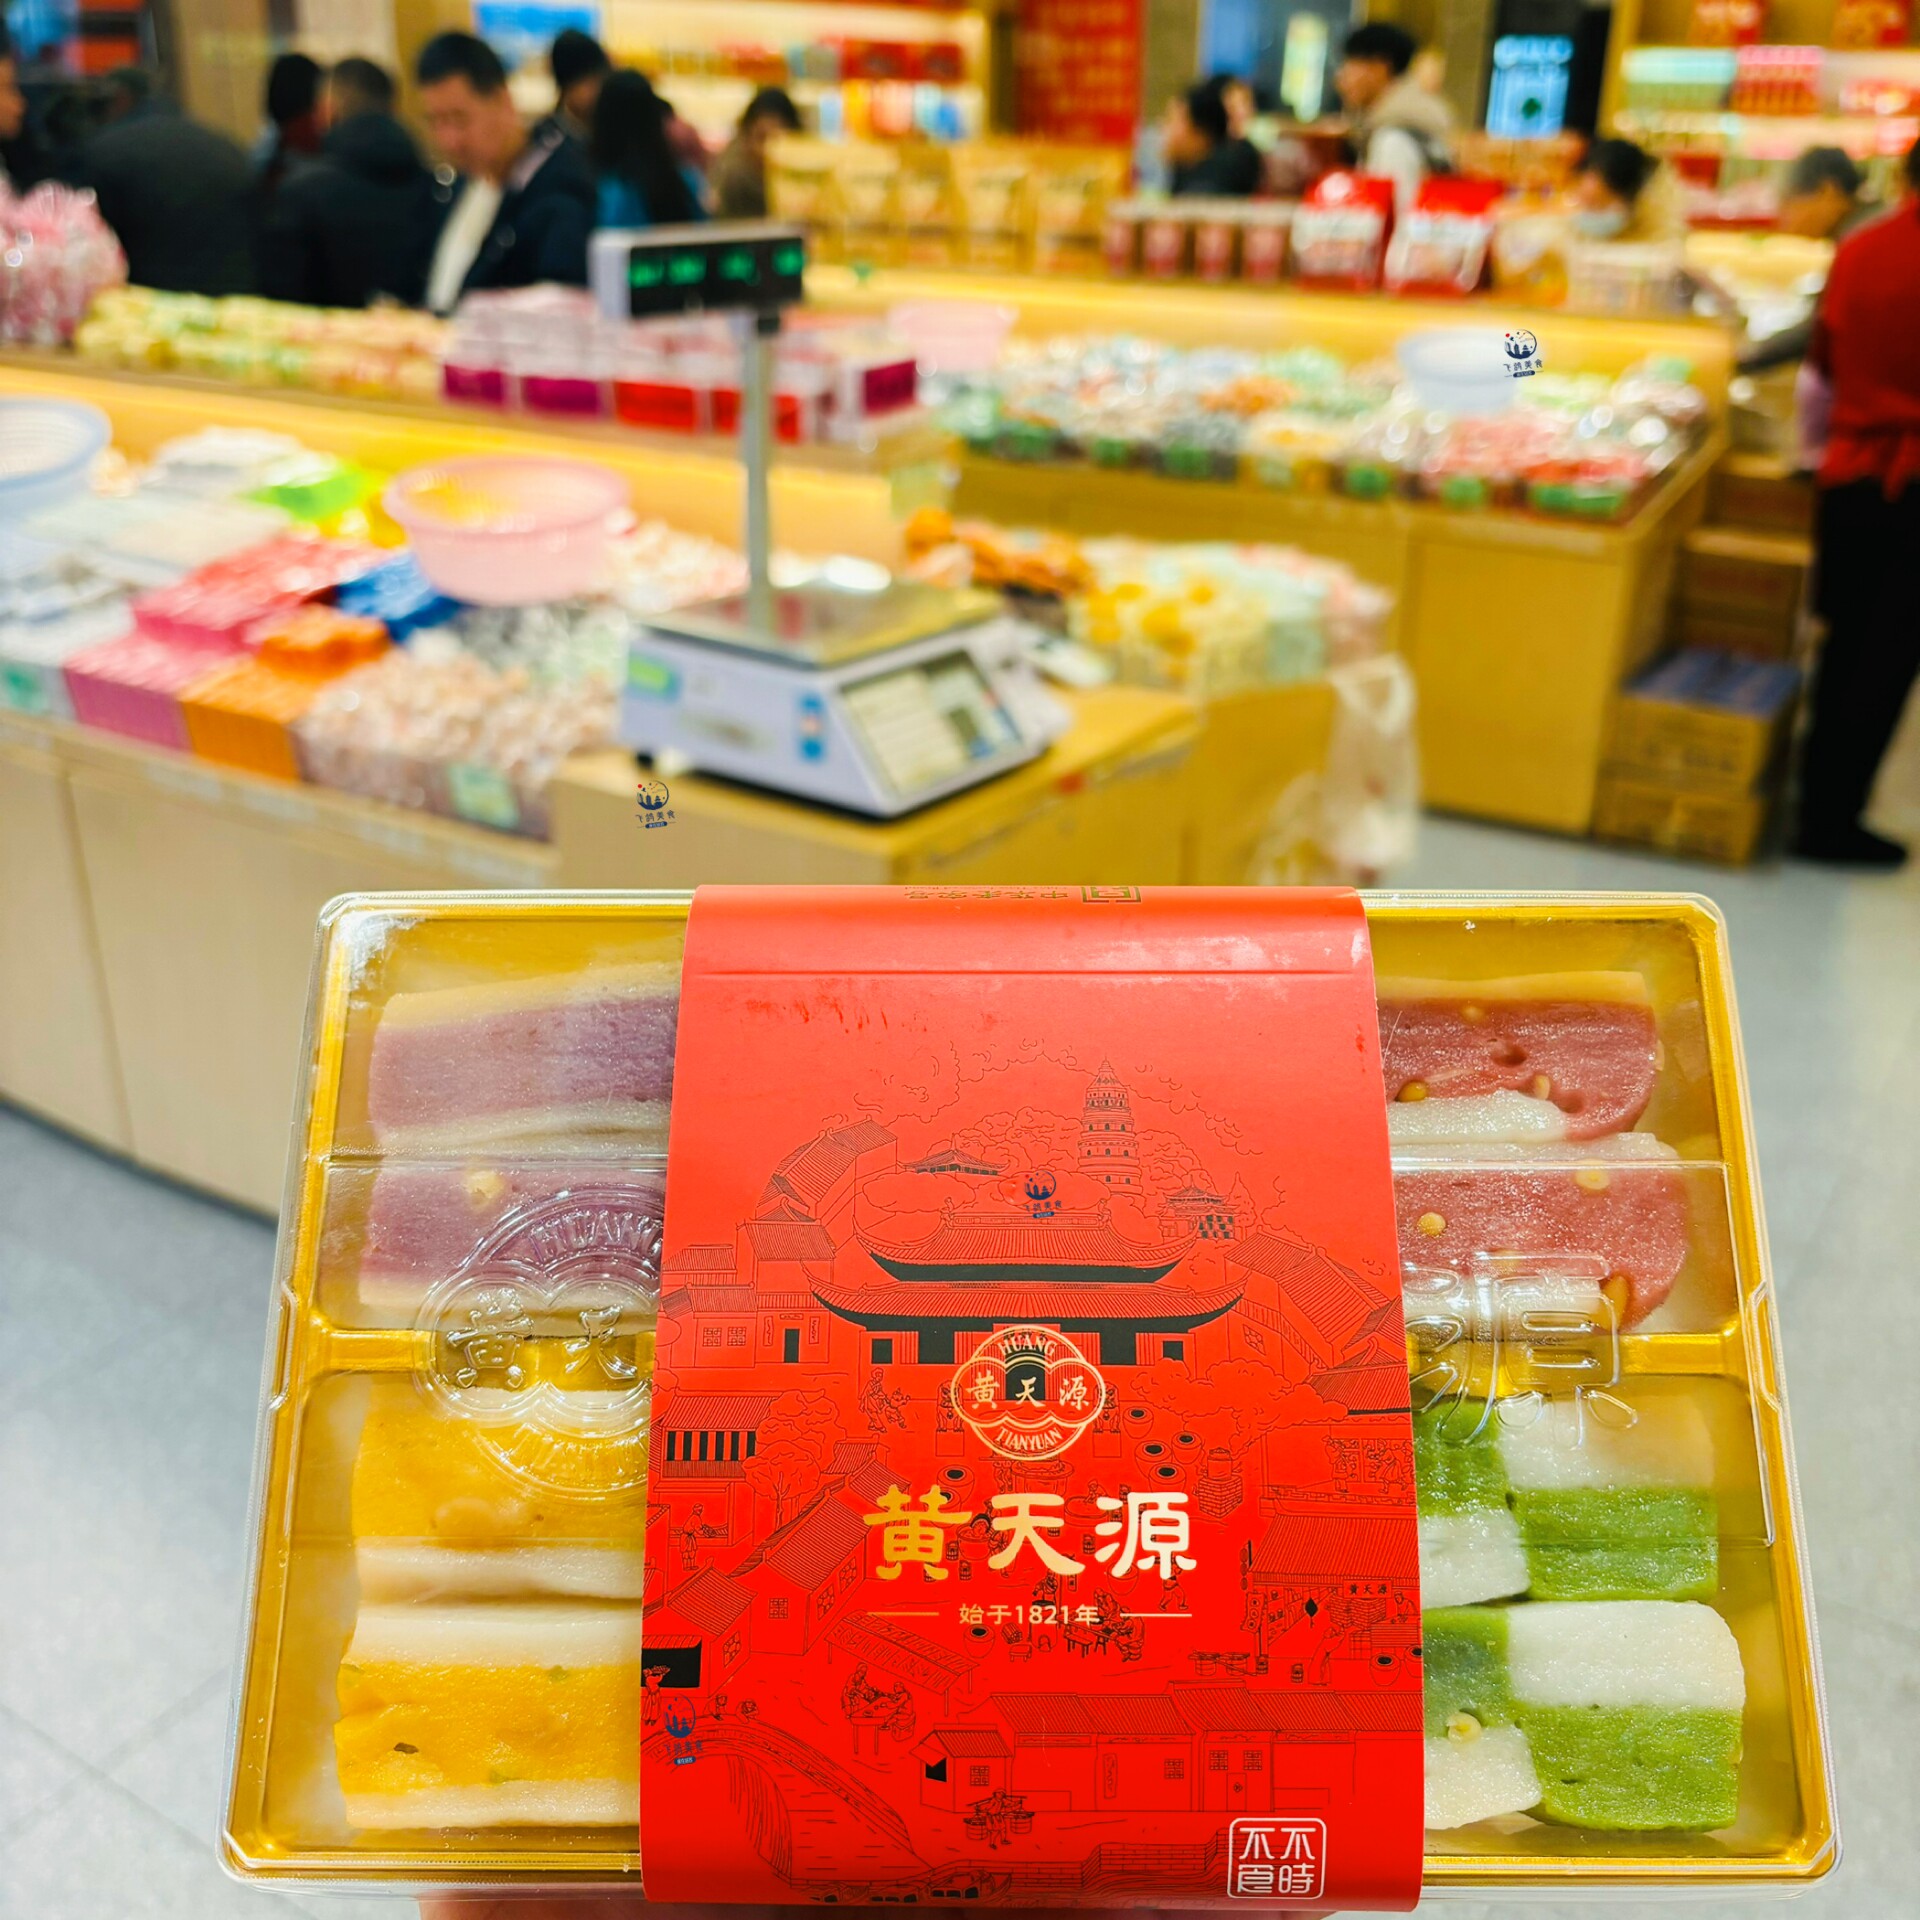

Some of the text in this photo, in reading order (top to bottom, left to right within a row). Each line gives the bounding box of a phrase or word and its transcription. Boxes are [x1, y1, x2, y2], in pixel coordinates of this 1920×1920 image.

[904, 890, 1068, 899] 中华老字号
[997, 1334, 1058, 1357] HUANG
[965, 1369, 1090, 1411] 黄天源
[995, 1426, 1063, 1451] TIANYUAN
[863, 1484, 1198, 1580] 黄天源
[958, 1603, 1101, 1626] 始于1821年
